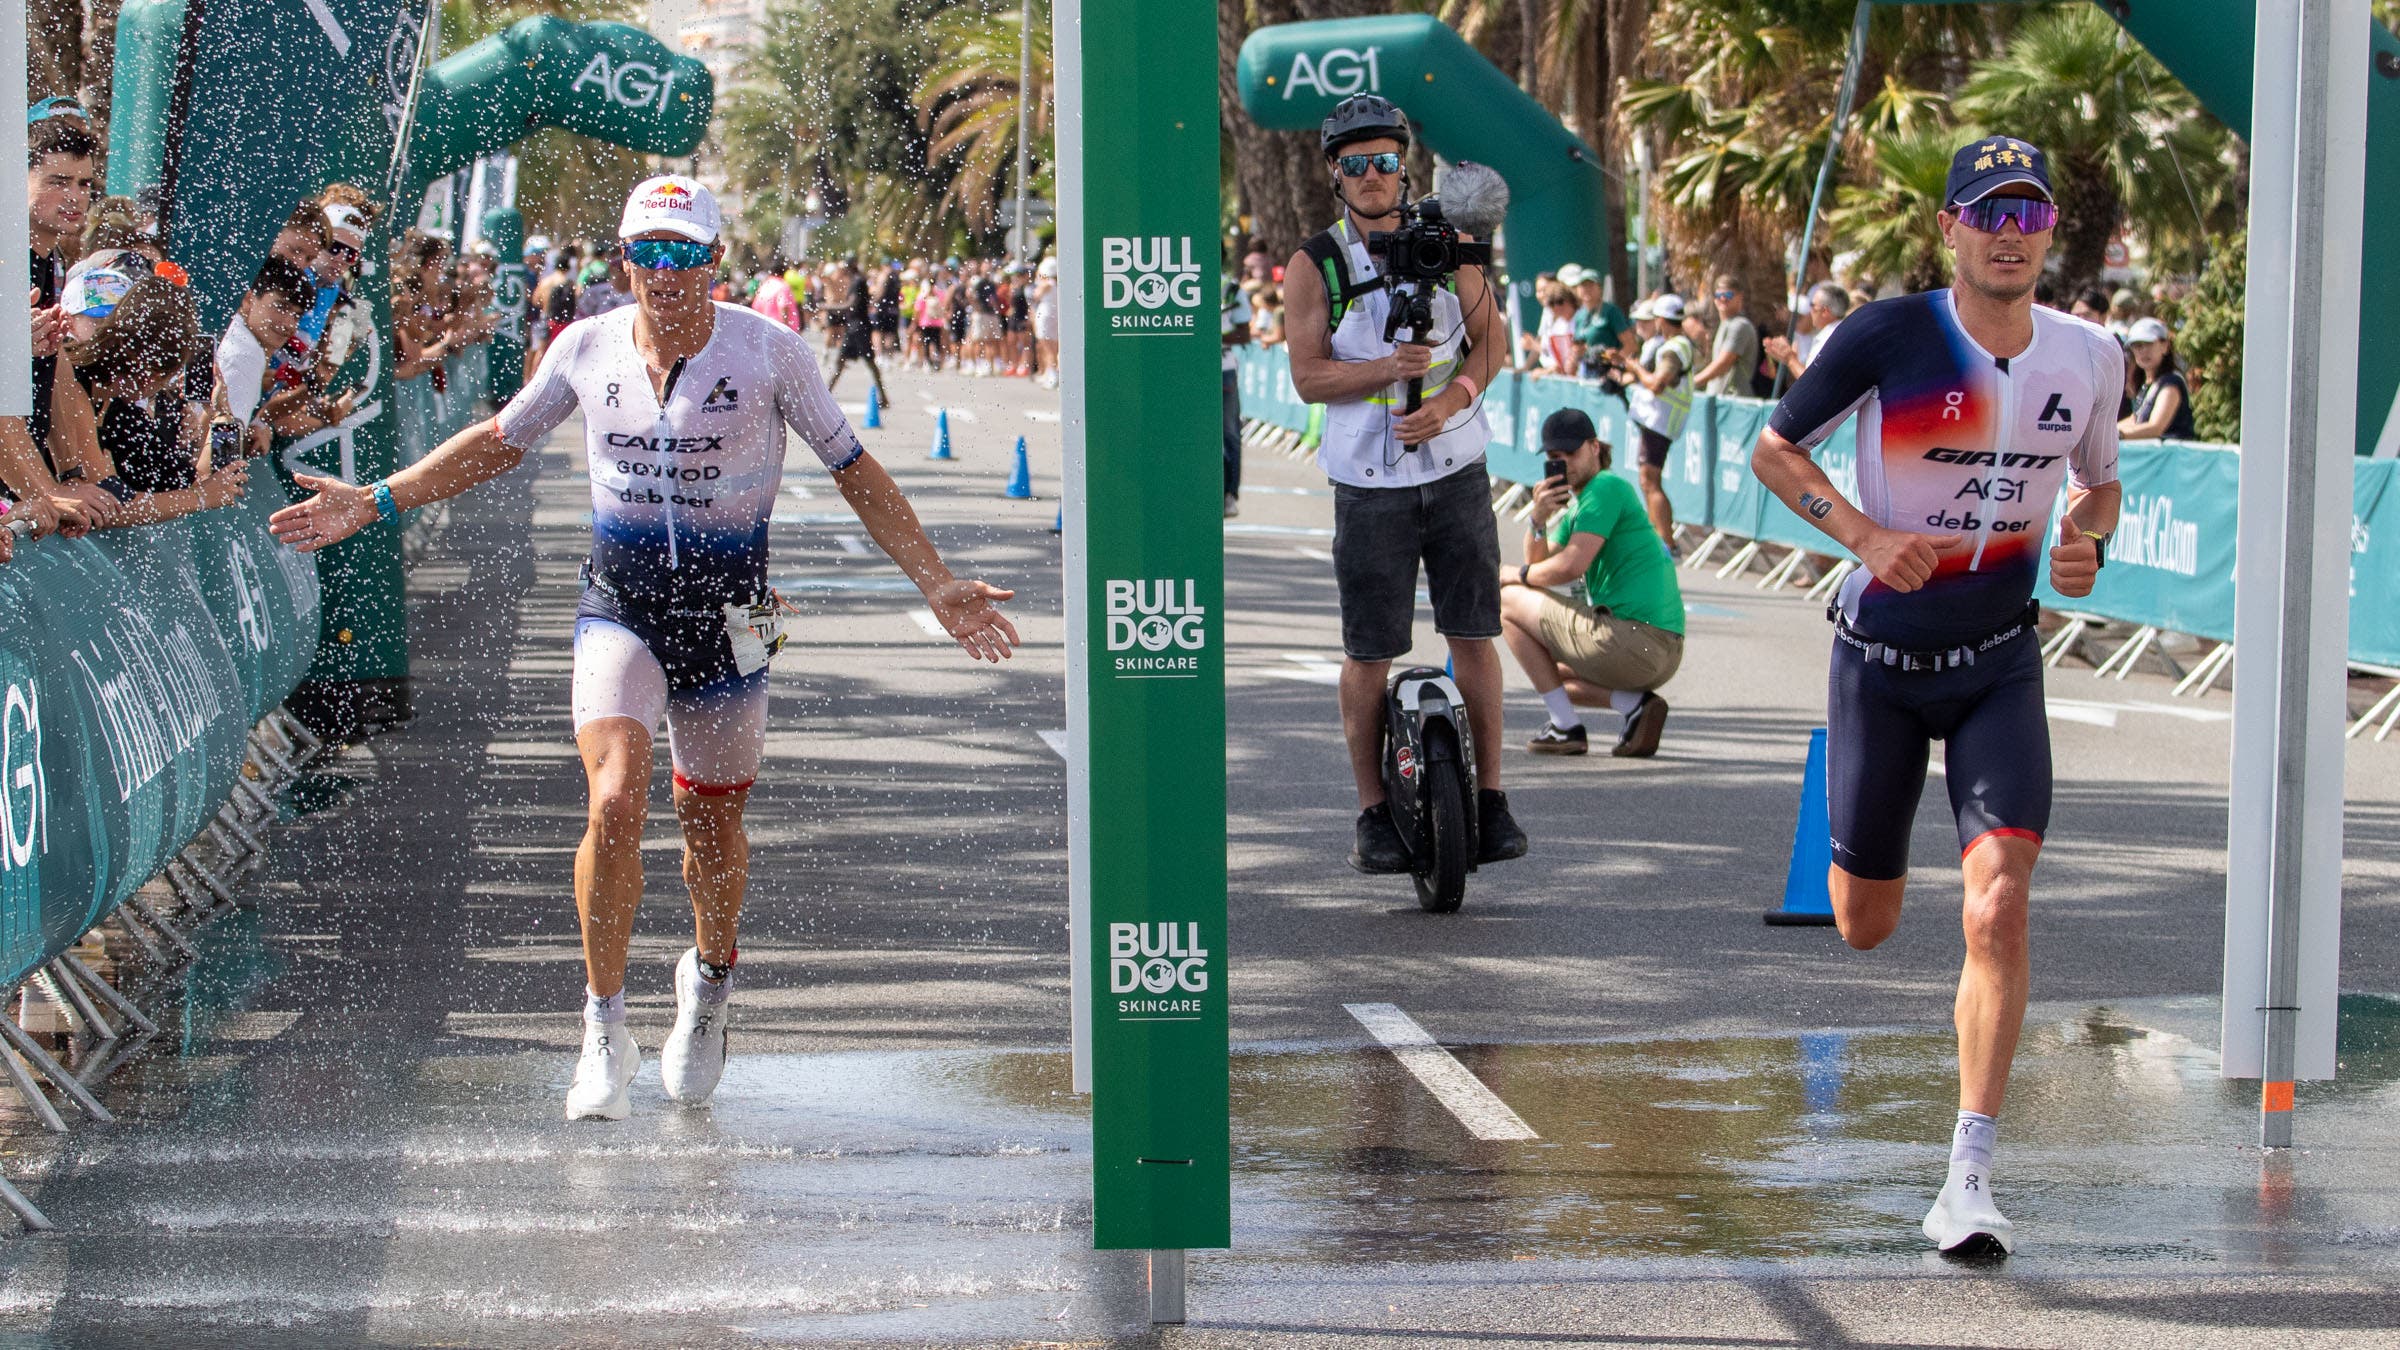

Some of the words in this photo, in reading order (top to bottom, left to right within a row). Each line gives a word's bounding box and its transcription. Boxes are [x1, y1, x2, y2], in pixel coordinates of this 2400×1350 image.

[571, 51, 676, 114] AG1
[1282, 46, 1382, 100] AG1
[644, 198, 667, 210] Red
[669, 198, 693, 212] Bull
[1102, 236, 1201, 273] BULL
[1103, 272, 1202, 309] DOG
[1111, 315, 1195, 328] SKINCARE
[701, 403, 739, 414] surpas
[2037, 423, 2073, 433] surpas
[607, 432, 727, 454] CADEX
[616, 460, 722, 481] GOWOD
[1922, 447, 2064, 470] GIANT
[620, 488, 715, 509] deboer
[1954, 477, 2029, 503] AG1
[1808, 496, 1834, 521] 6
[1926, 509, 2032, 533] deboer
[1106, 578, 1205, 615] BULL
[1106, 614, 1205, 652] DOG
[1978, 622, 2022, 653] deboer
[1115, 657, 1198, 670] SKINCARE
[0, 677, 49, 871] G1
[1110, 921, 1208, 958] BULL
[1110, 957, 1208, 994] DOG
[1119, 999, 1201, 1012] SKINCARE
